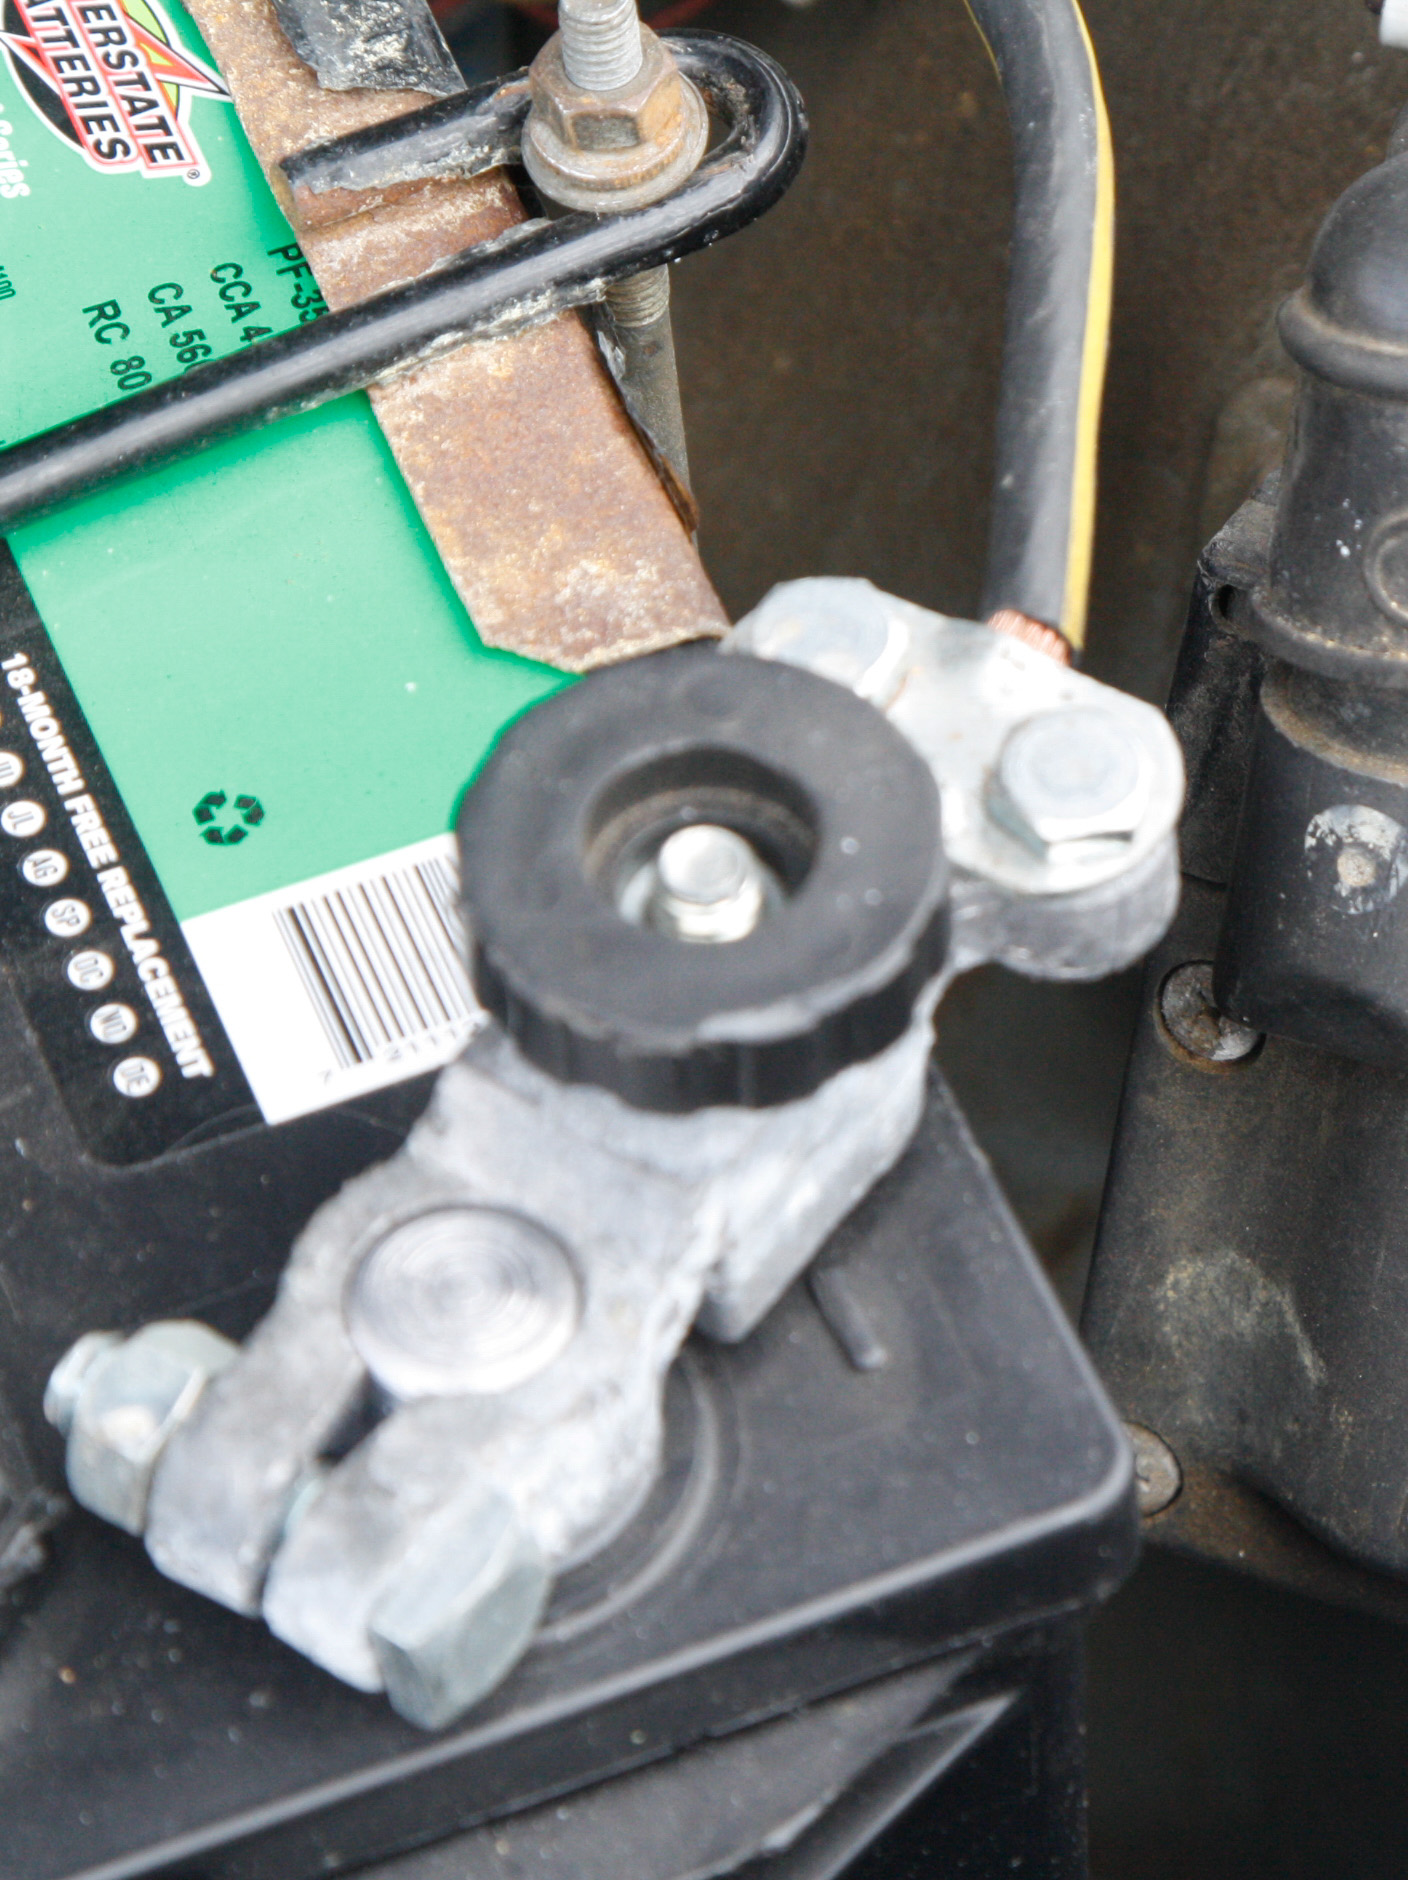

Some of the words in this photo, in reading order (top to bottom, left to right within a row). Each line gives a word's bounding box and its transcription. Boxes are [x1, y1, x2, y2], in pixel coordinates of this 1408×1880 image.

[148, 282, 192, 328] CA
[210, 262, 261, 323] CCA
[82, 299, 131, 345] RC
[110, 356, 152, 390] 80
[1, 652, 86, 796] 18-MONTH
[64, 793, 119, 869] FREE
[97, 866, 214, 1079] REPLACEMENT
[27, 857, 58, 880] AG
[51, 904, 81, 927] SP
